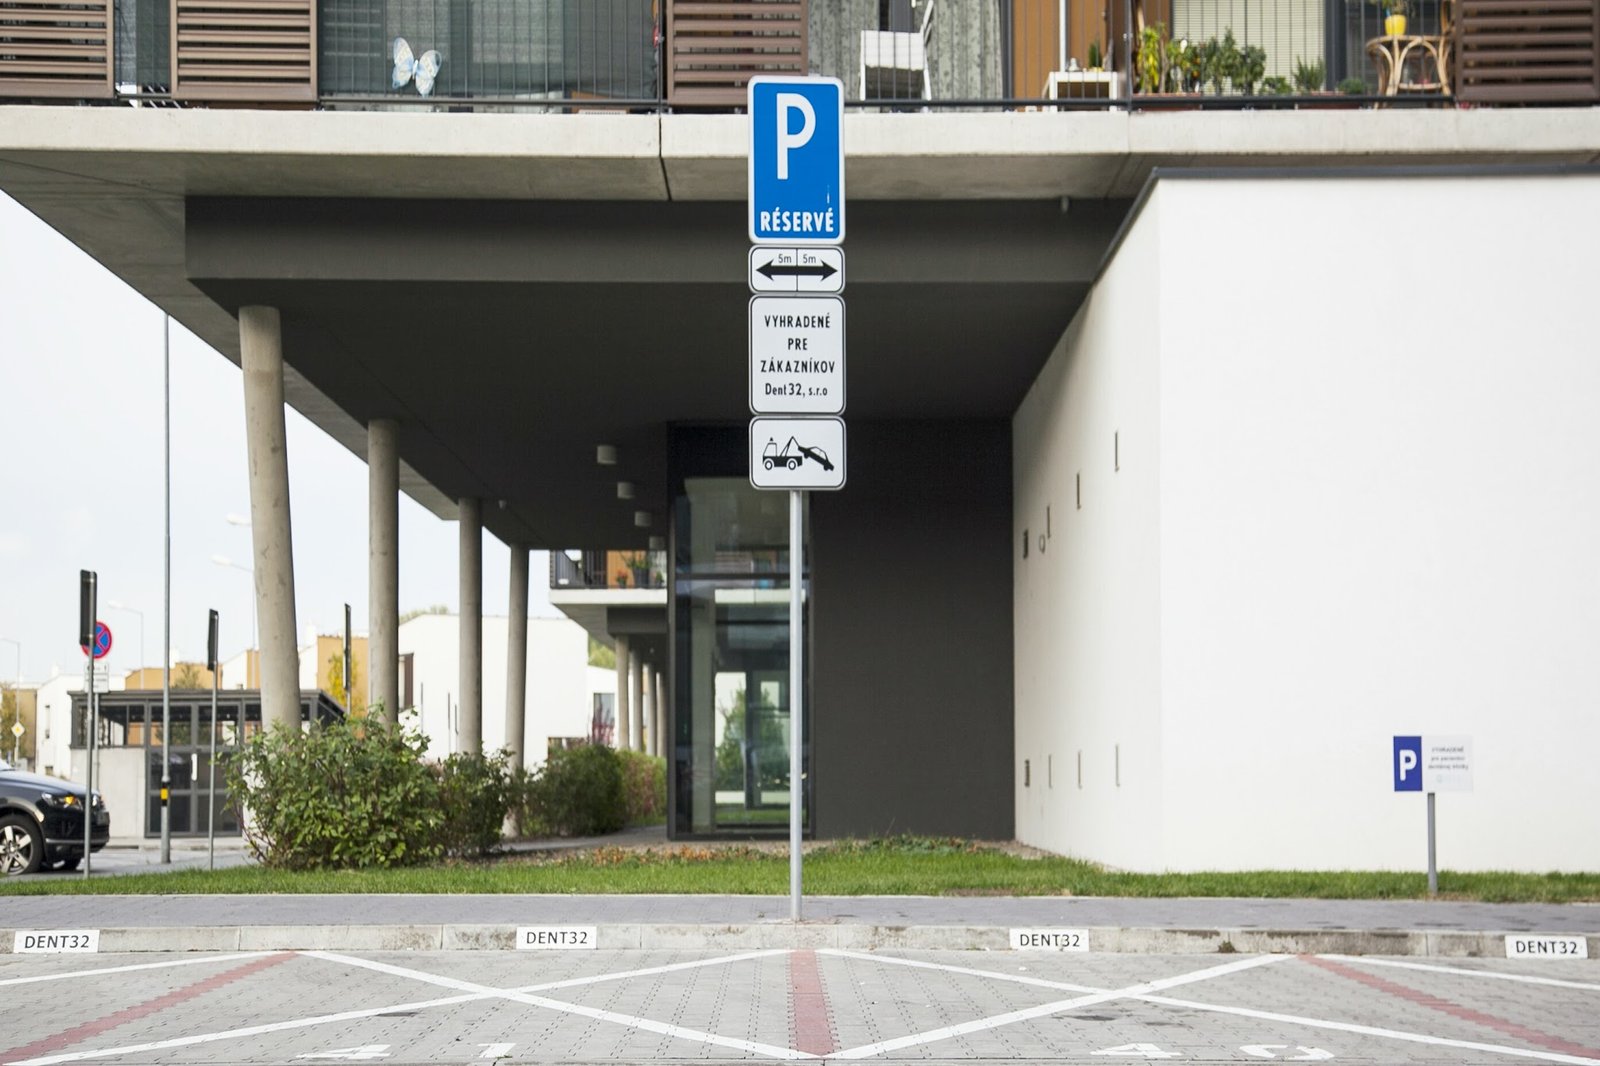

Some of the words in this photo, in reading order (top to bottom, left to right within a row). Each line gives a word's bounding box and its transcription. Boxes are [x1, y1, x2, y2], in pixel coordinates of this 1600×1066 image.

[776, 92, 817, 180] P
[760, 206, 834, 233] RÉSERVÉ
[778, 253, 792, 264] 5m
[802, 253, 817, 264] 5m
[764, 312, 831, 329] VYHRADENÉ
[787, 337, 808, 351] PRE
[760, 356, 835, 374] ZÁKAZNÍKOV
[1399, 748, 1417, 782] P
[24, 934, 90, 949] DENT32
[526, 931, 588, 945] DENT32
[1019, 933, 1081, 948] DENT32
[1516, 940, 1579, 955] DENT32
